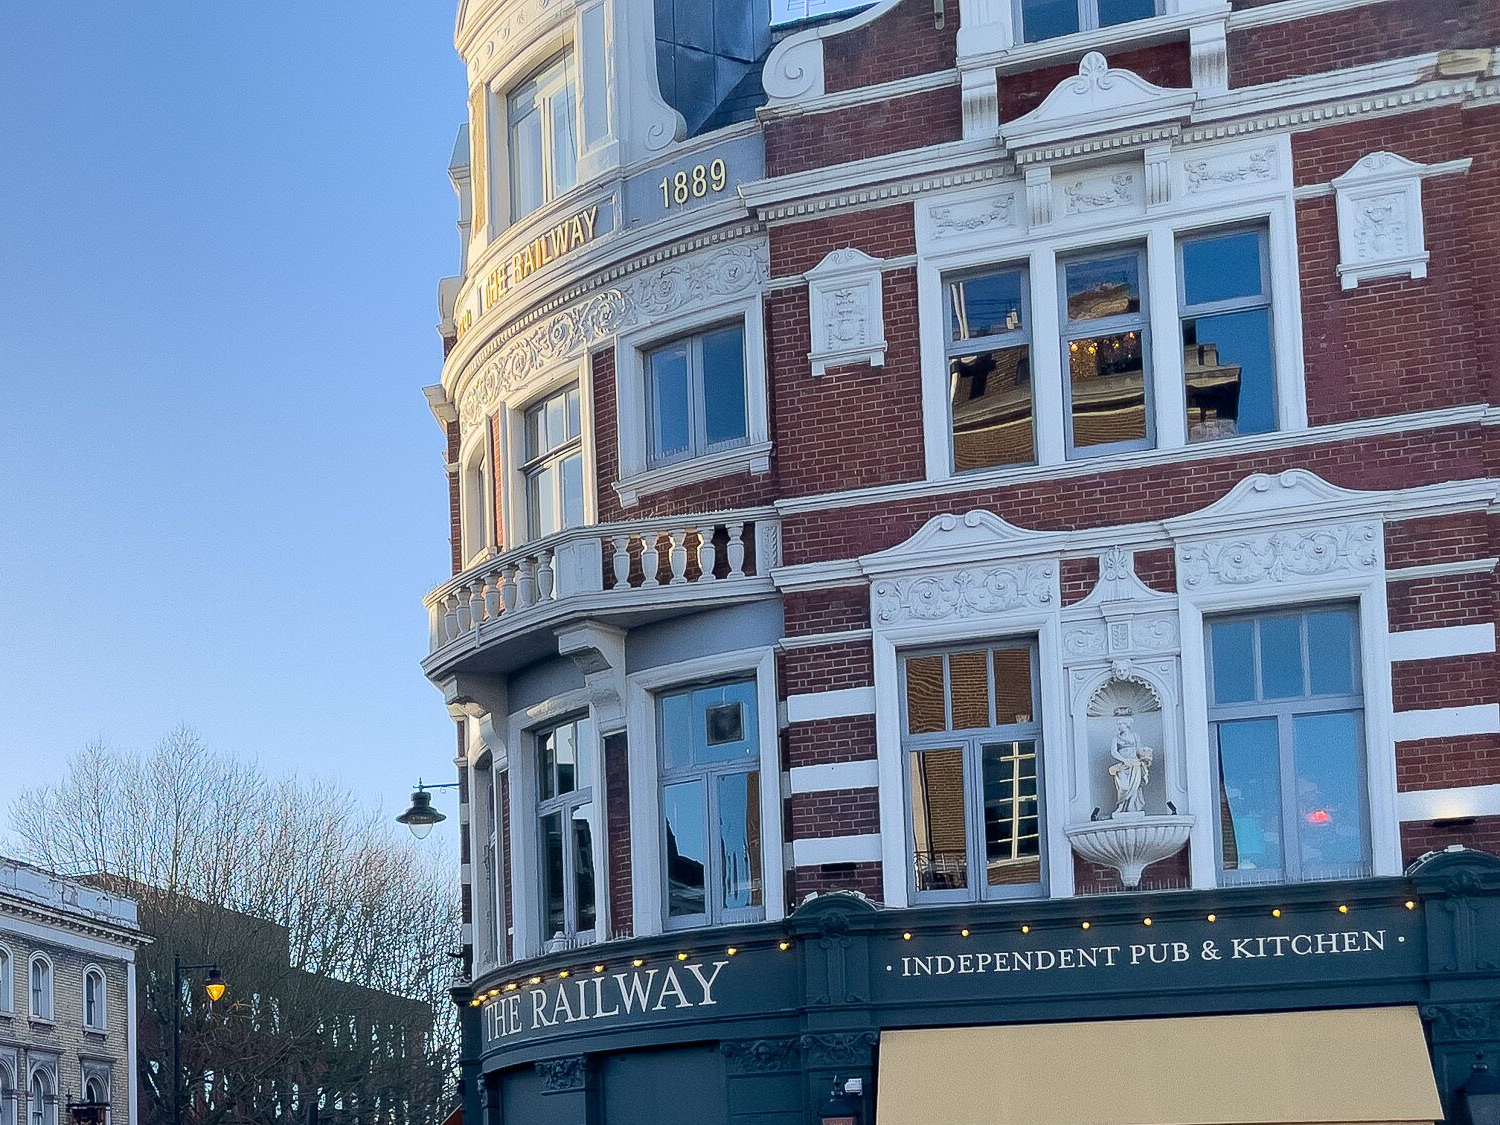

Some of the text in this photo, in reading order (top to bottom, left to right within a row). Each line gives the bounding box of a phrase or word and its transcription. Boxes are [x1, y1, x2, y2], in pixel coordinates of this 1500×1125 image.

[658, 157, 727, 209] 1889
[512, 204, 599, 284] RAILWAY
[901, 929, 1387, 977] INDEPENDENT PUB & KITCHEN
[484, 960, 729, 1043] THE RAILWAY
